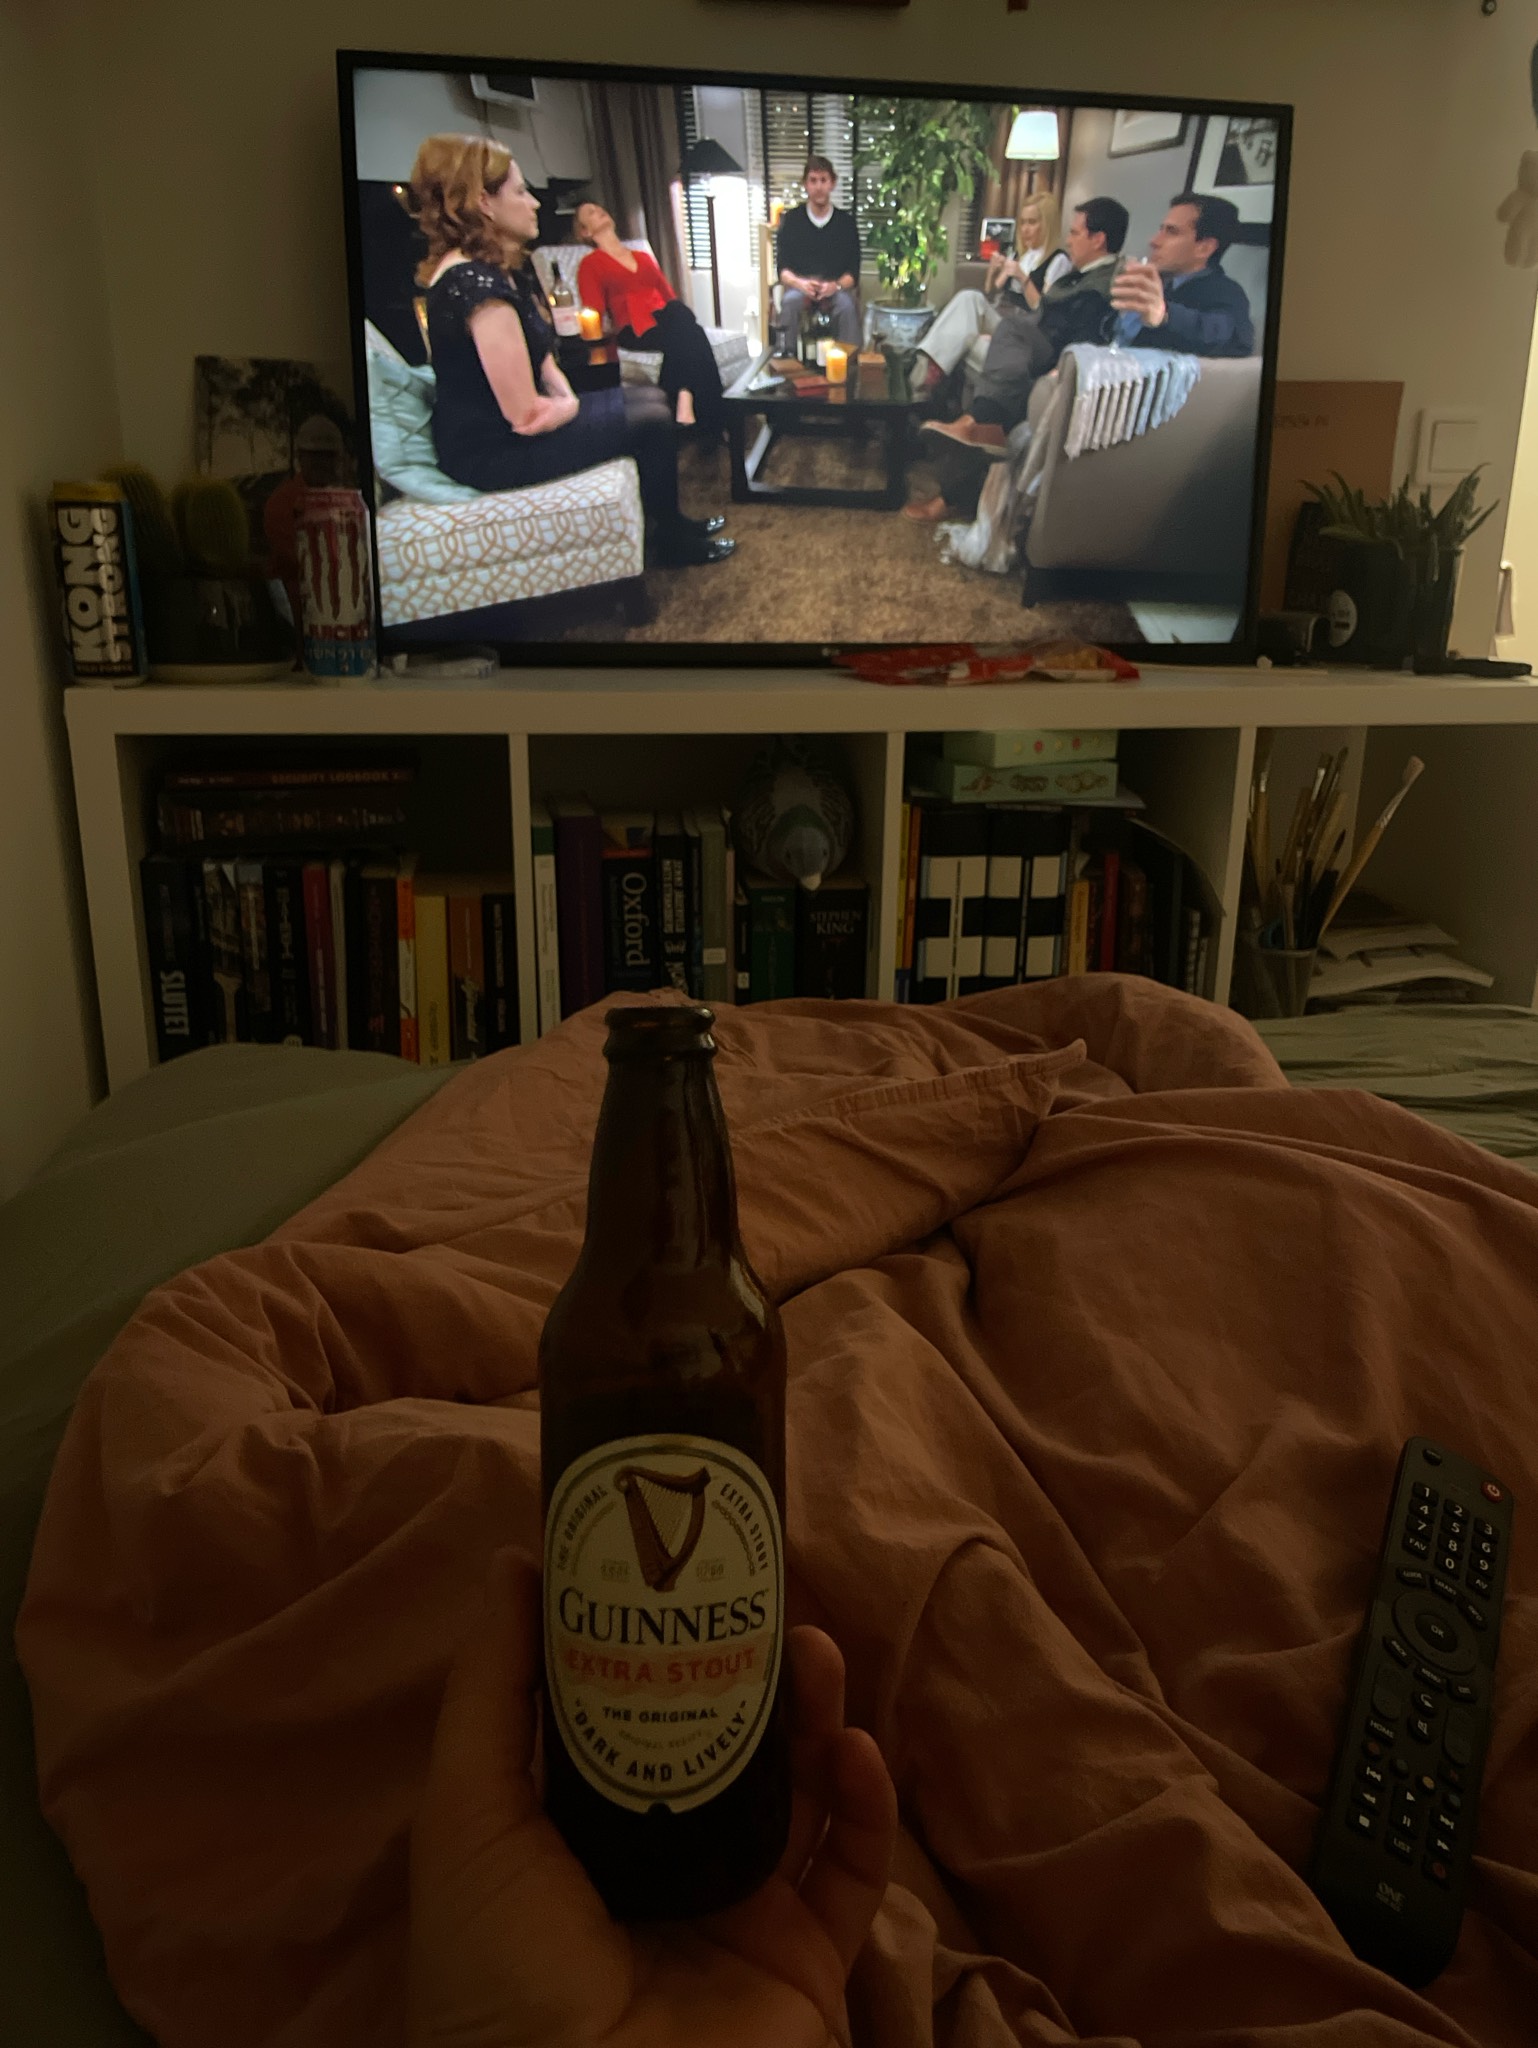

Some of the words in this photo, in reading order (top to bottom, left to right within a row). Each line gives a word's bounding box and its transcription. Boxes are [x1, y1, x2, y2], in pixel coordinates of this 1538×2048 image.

[58, 506, 105, 664] KONG
[90, 506, 133, 664] STRONG
[621, 871, 651, 967] Oxford
[809, 910, 863, 922] STEPHEN
[816, 921, 855, 935] KING
[159, 969, 191, 1037] SLUTET
[1419, 1505, 1429, 1515] 4
[1453, 1505, 1463, 1517] 2
[720, 1482, 752, 1522] EXTRA
[749, 1522, 769, 1571] STOUT
[1417, 1520, 1427, 1531] 7
[1451, 1522, 1460, 1534] 5
[1485, 1523, 1493, 1536] 3
[1409, 1537, 1427, 1551] FAV
[1448, 1539, 1458, 1552] 8
[1481, 1542, 1491, 1553] 6
[1479, 1559, 1489, 1571] 9
[1475, 1578, 1488, 1590] AV
[559, 1586, 766, 1646] GUINNESS
[1431, 1624, 1444, 1638] OK
[565, 1648, 653, 1683] EXTRA
[666, 1646, 756, 1683] STOUT
[602, 1706, 632, 1722] THE
[638, 1707, 719, 1723] ORIGINAL
[1370, 1719, 1395, 1739] HOME
[626, 1760, 672, 1782] AND
[1393, 1837, 1412, 1853] LIST
